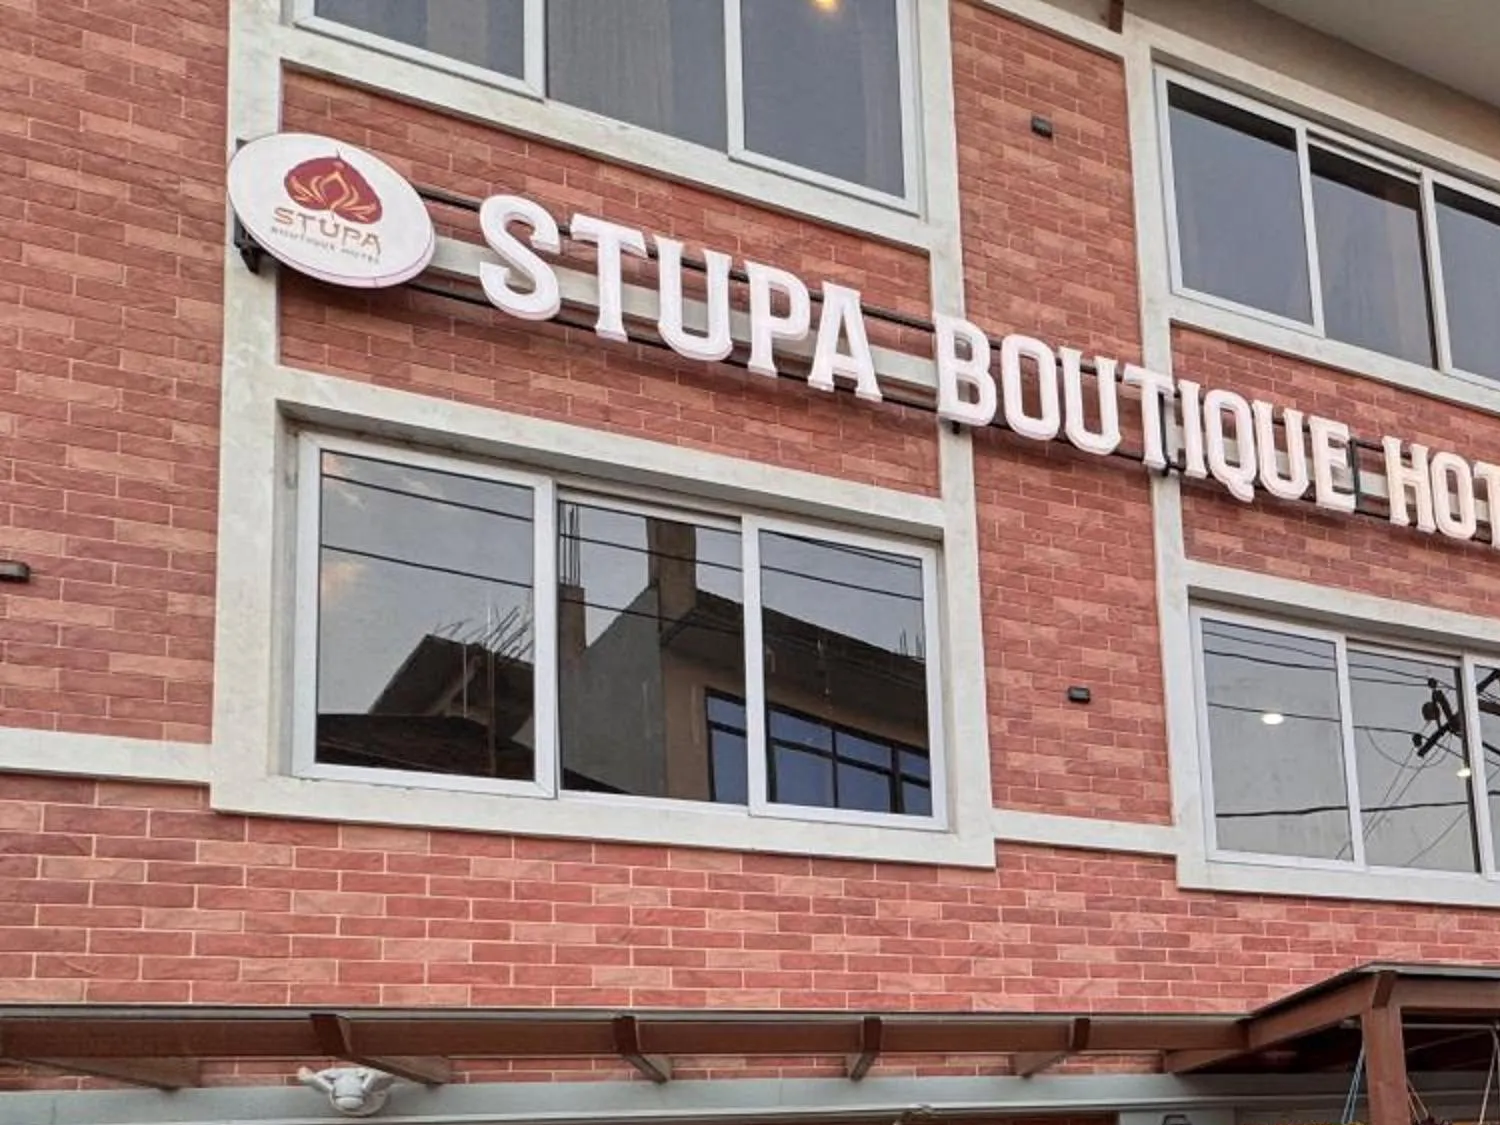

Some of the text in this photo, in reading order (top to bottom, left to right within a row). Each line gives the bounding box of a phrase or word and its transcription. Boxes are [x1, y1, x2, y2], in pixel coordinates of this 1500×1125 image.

[272, 206, 382, 256] STUPA
[479, 194, 882, 401] STUPA
[936, 314, 1356, 513] BOUTIQUE
